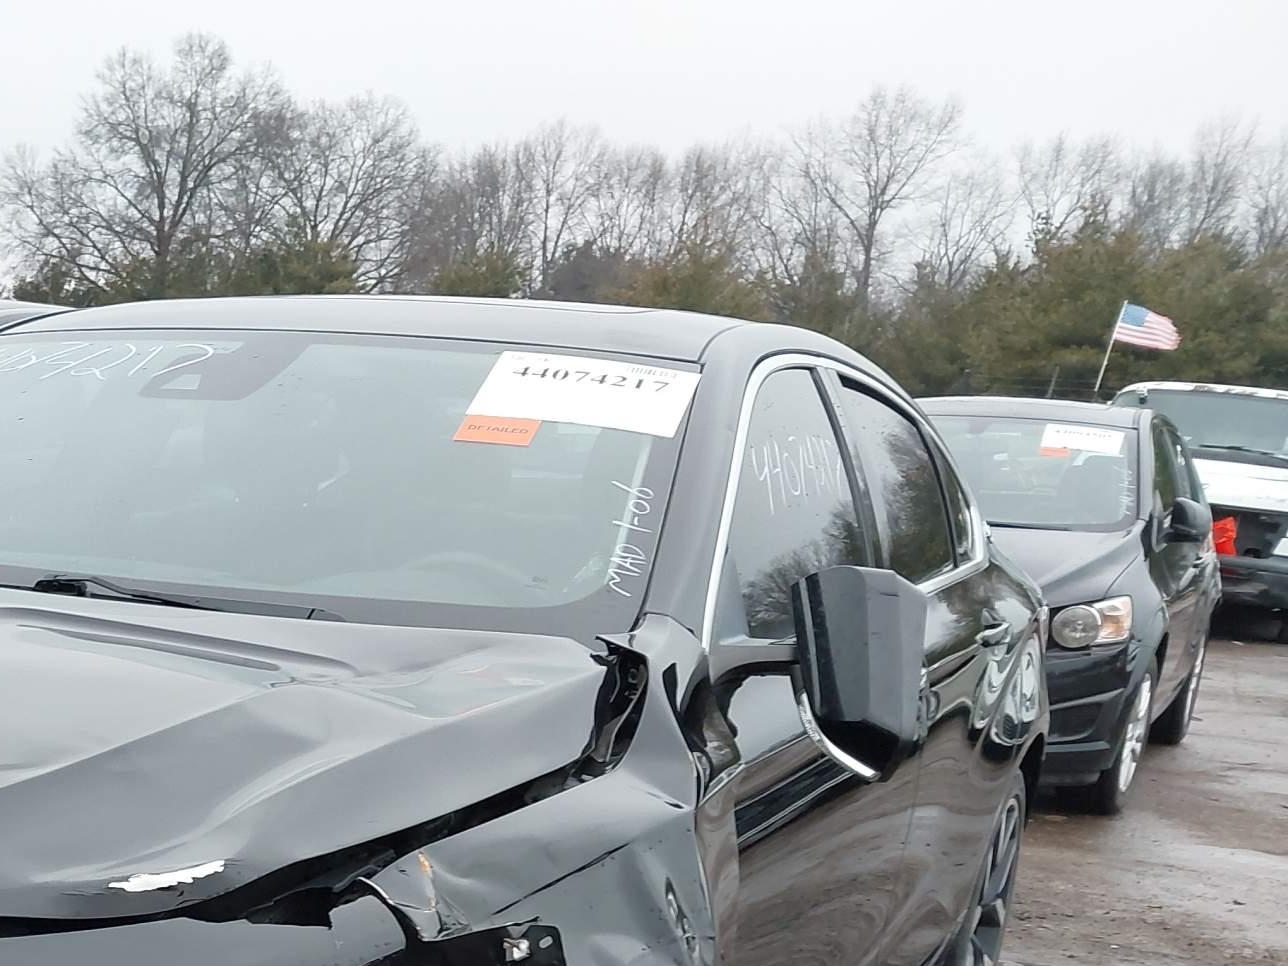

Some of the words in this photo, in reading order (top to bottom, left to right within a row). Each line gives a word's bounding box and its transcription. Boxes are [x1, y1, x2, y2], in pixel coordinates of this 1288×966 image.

[512, 365, 670, 393] 44074217
[467, 423, 529, 435] DETAILED
[609, 542, 647, 597] MAD
